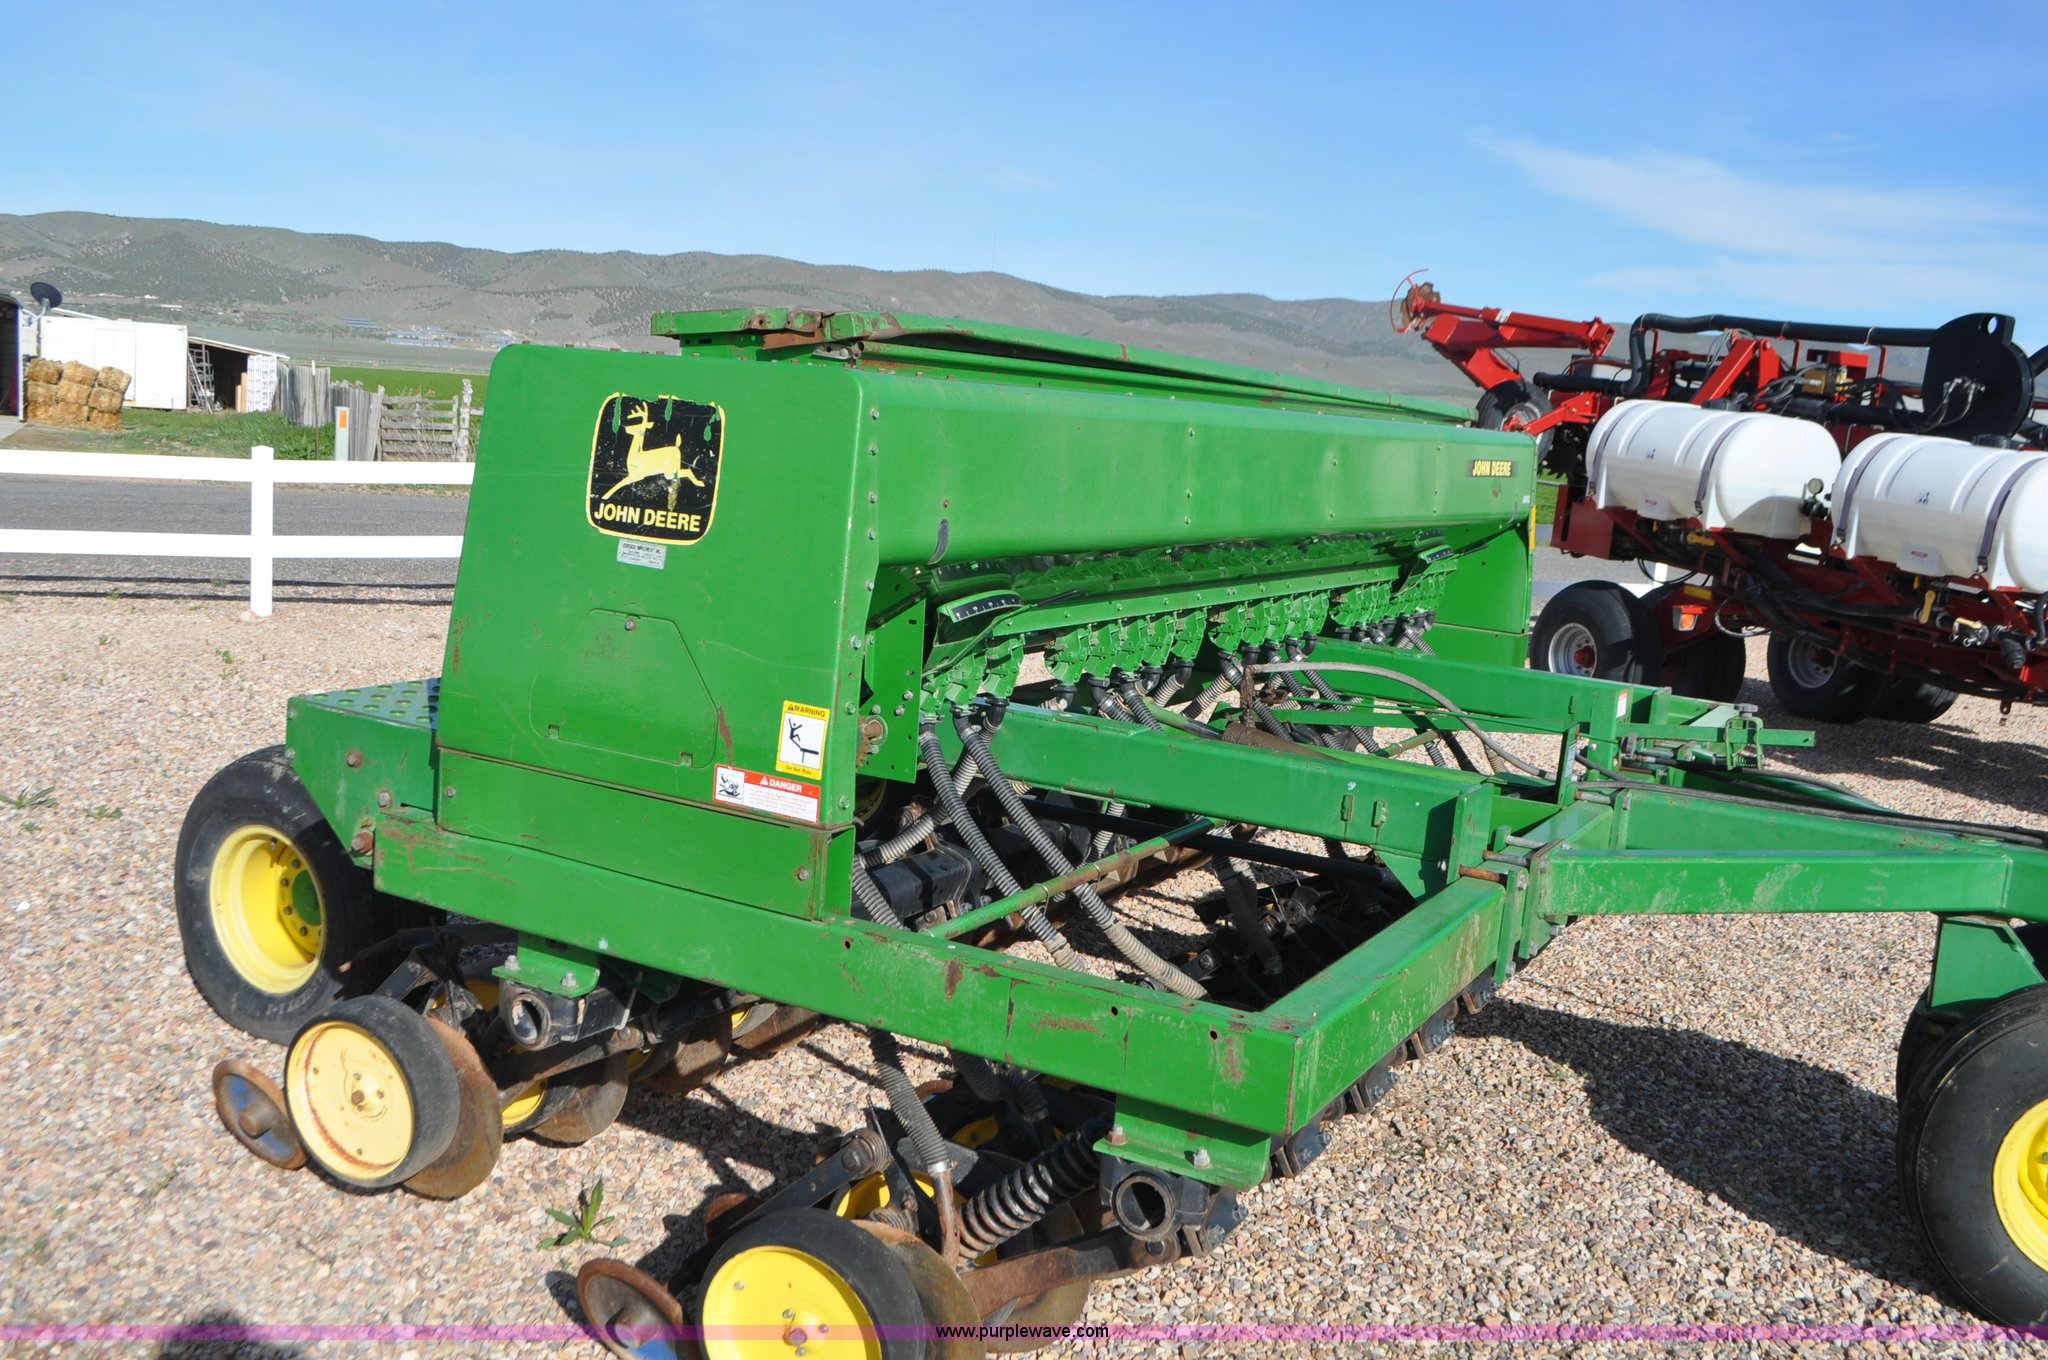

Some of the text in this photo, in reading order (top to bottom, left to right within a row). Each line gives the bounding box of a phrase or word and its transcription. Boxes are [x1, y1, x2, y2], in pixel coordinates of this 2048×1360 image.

[1472, 460, 1512, 477] JOHN DEERE
[594, 503, 701, 532] JOHN DEERE
[795, 704, 826, 718] WARNING
[769, 778, 803, 793] DANGER
